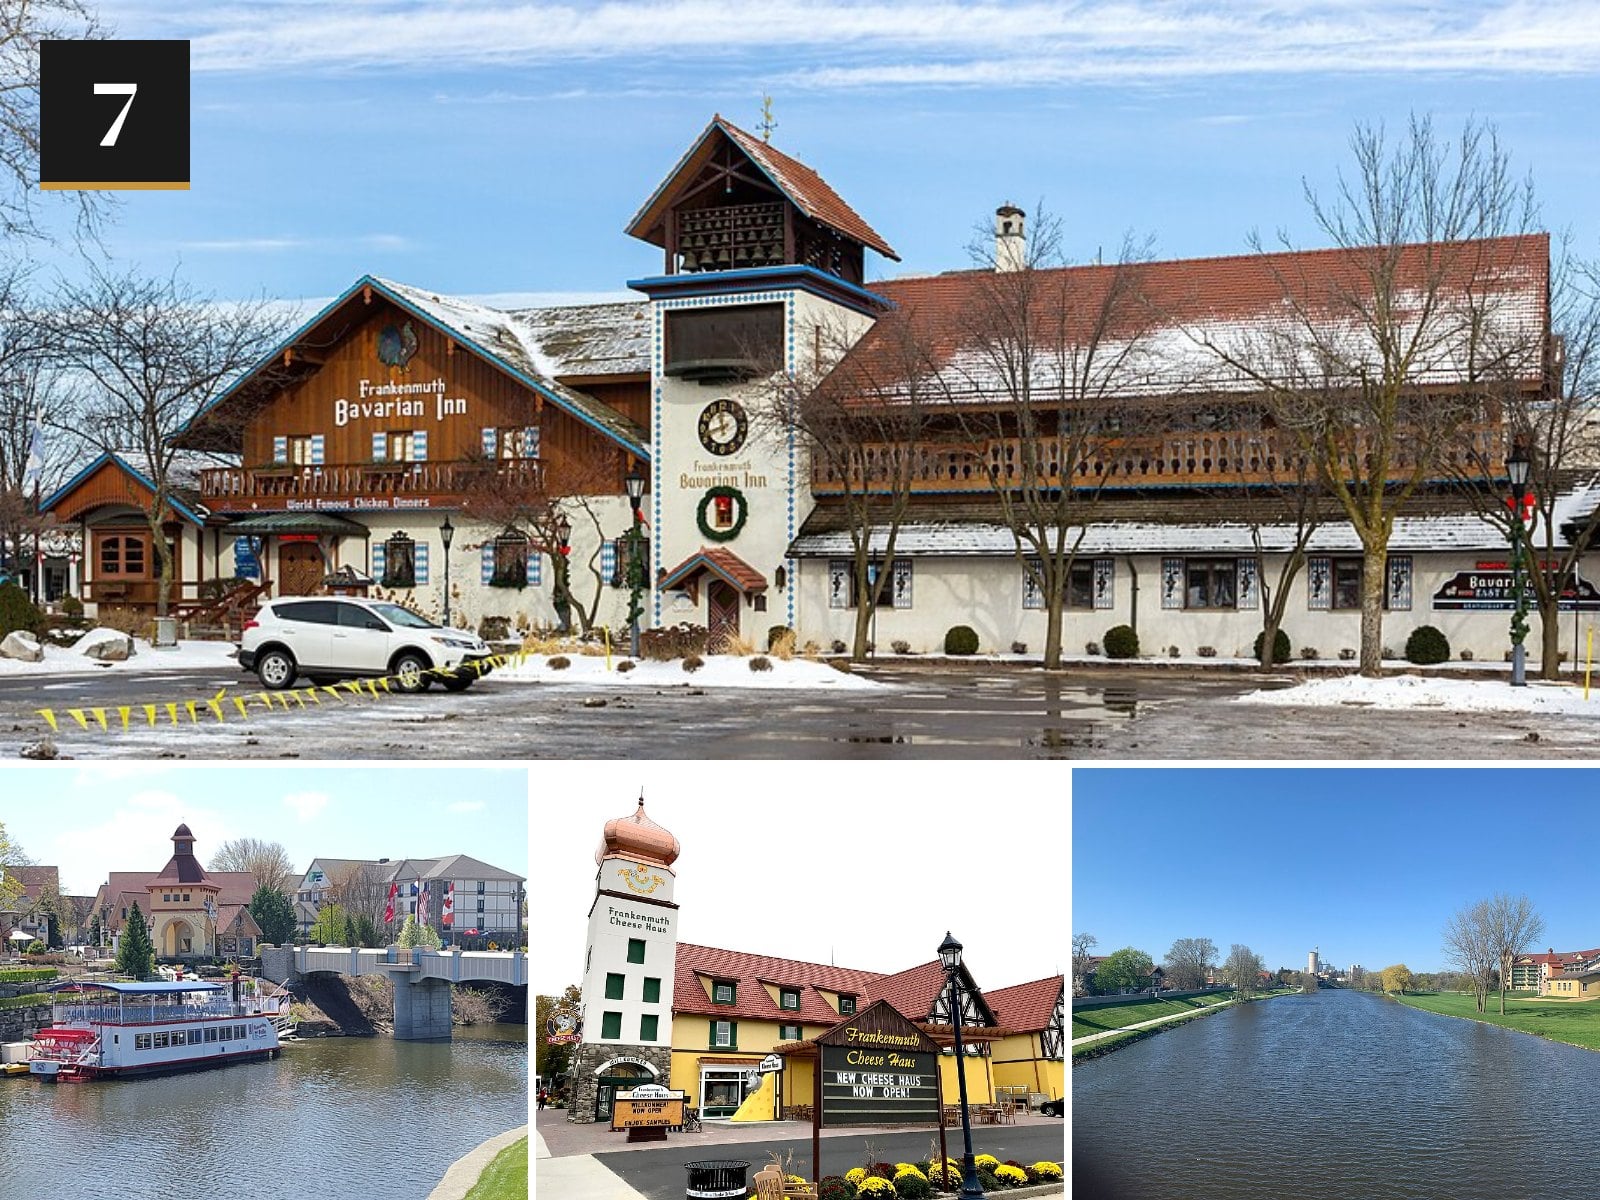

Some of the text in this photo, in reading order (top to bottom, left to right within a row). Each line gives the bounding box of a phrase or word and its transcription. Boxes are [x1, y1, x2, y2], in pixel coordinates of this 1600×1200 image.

[360, 378, 445, 398] Frankenmuth
[335, 394, 467, 426] Bavarian Inn
[694, 460, 752, 472] Frankenmuth
[680, 471, 768, 489] Bavarian Inn
[286, 496, 430, 510] World Famous Chicken Dinners
[1470, 575, 1534, 589] Bavarin
[608, 906, 670, 926] Frankenmuth
[609, 916, 667, 933] Cheese Haus
[845, 1027, 920, 1046] Frankenmuth
[846, 1050, 916, 1068] Cheese Haus
[836, 1072, 921, 1087] NEW CHEESE HAUS
[632, 1091, 653, 1099] Cheese
[853, 1086, 910, 1098] NOW OPEN!
